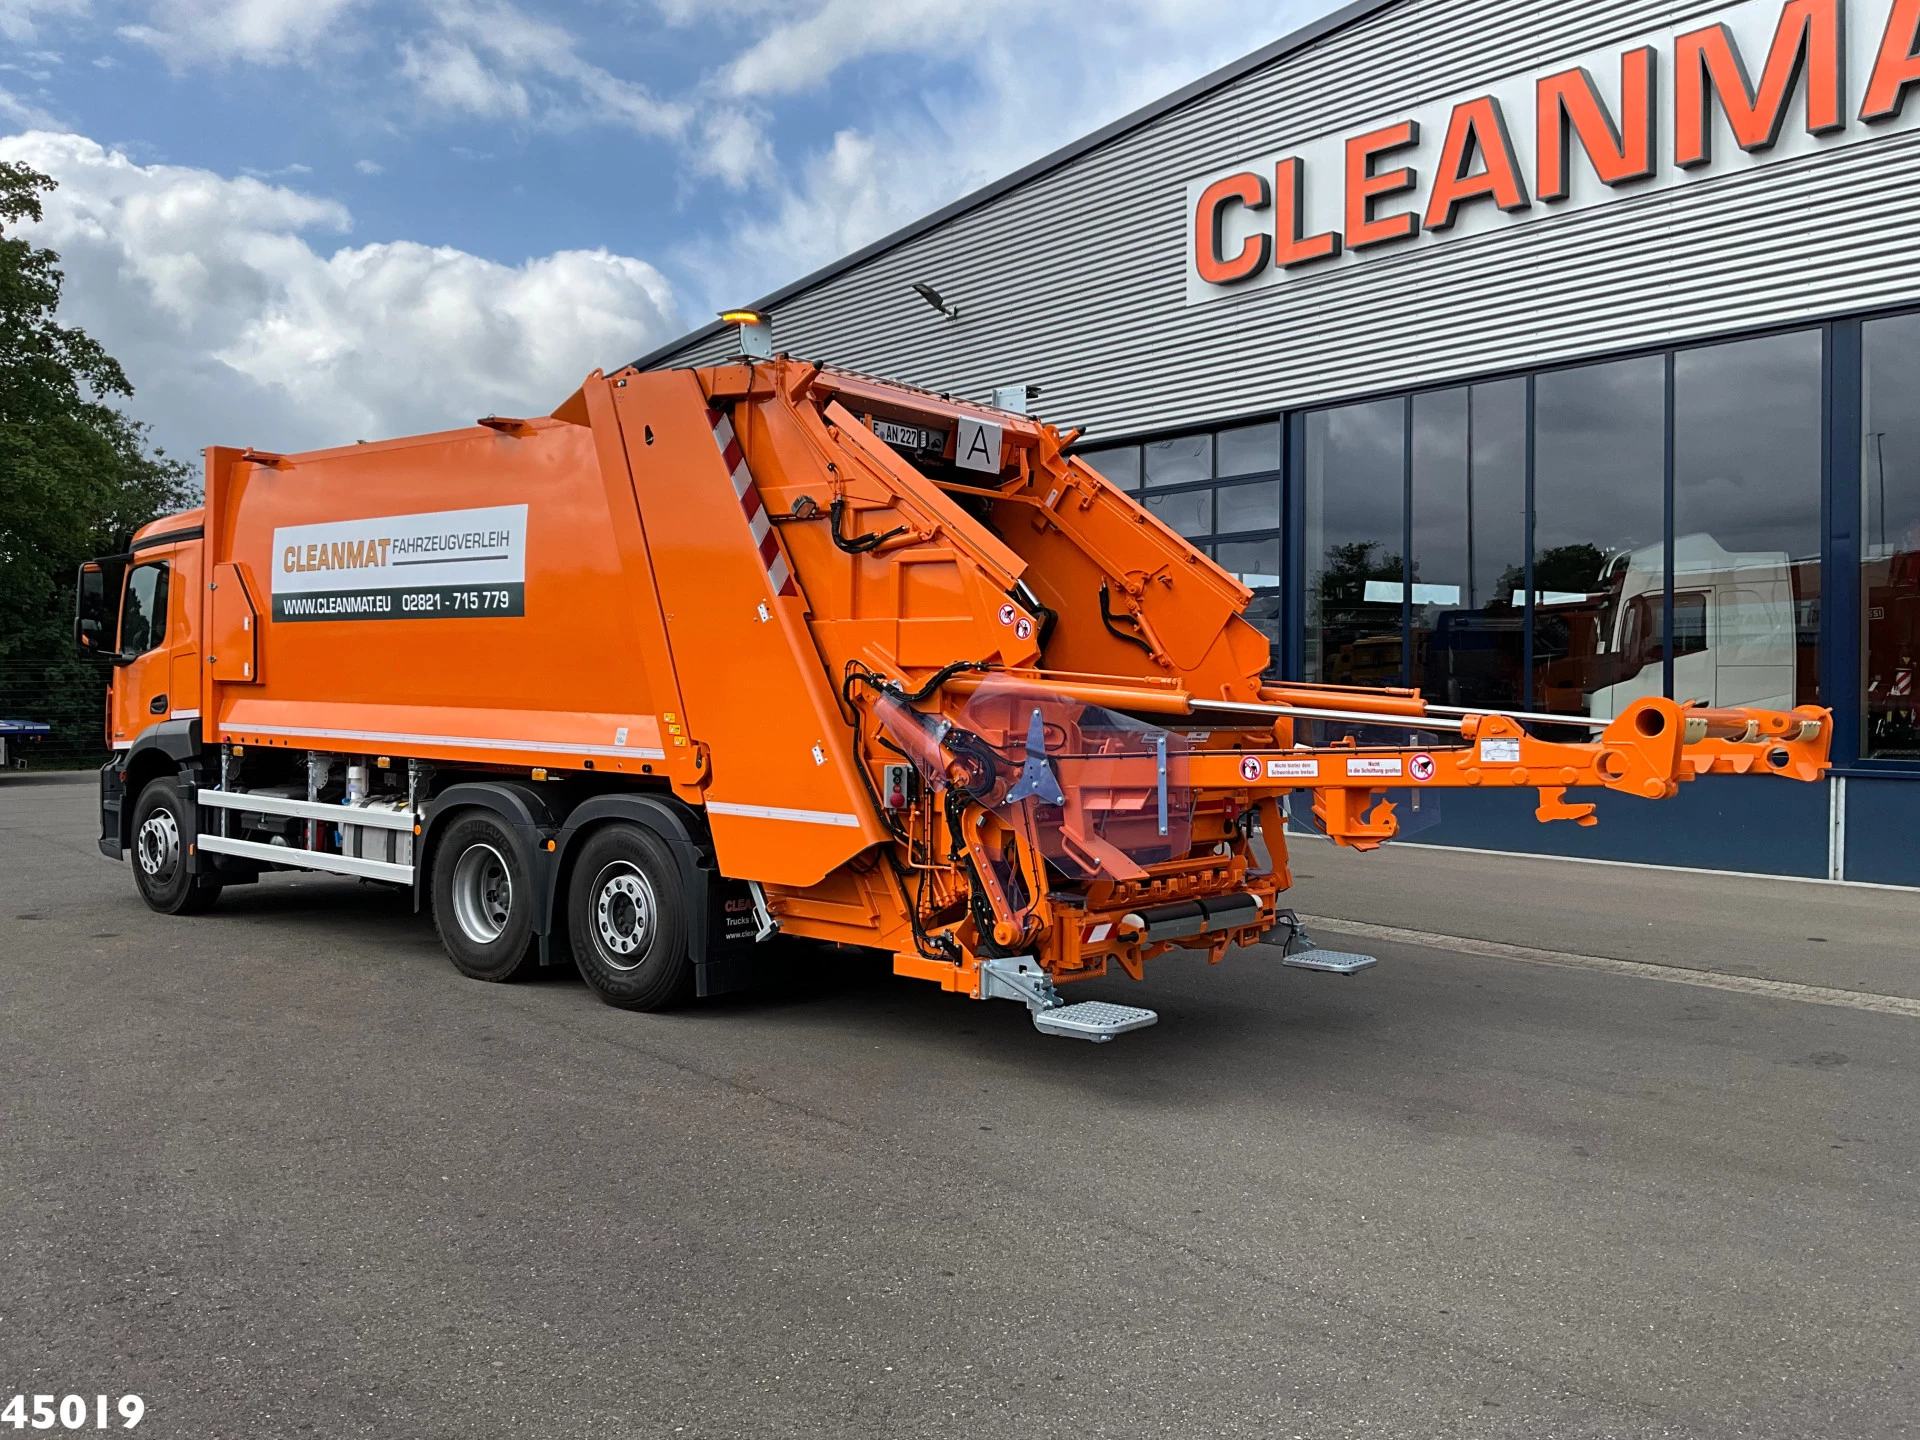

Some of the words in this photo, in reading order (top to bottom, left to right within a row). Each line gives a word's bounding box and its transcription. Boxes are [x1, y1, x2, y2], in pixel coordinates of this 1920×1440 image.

[886, 425, 898, 442] AN
[900, 428, 917, 446] 227
[966, 425, 990, 464] A
[283, 538, 391, 573] CLEANMAT
[392, 530, 510, 554] FAHRZEUGVERLEIH
[283, 595, 391, 615] WWW.CLEANMAT.EU
[402, 593, 440, 612] 02821
[453, 592, 478, 610] 715
[482, 591, 509, 608] 779
[726, 916, 750, 926] Trucks
